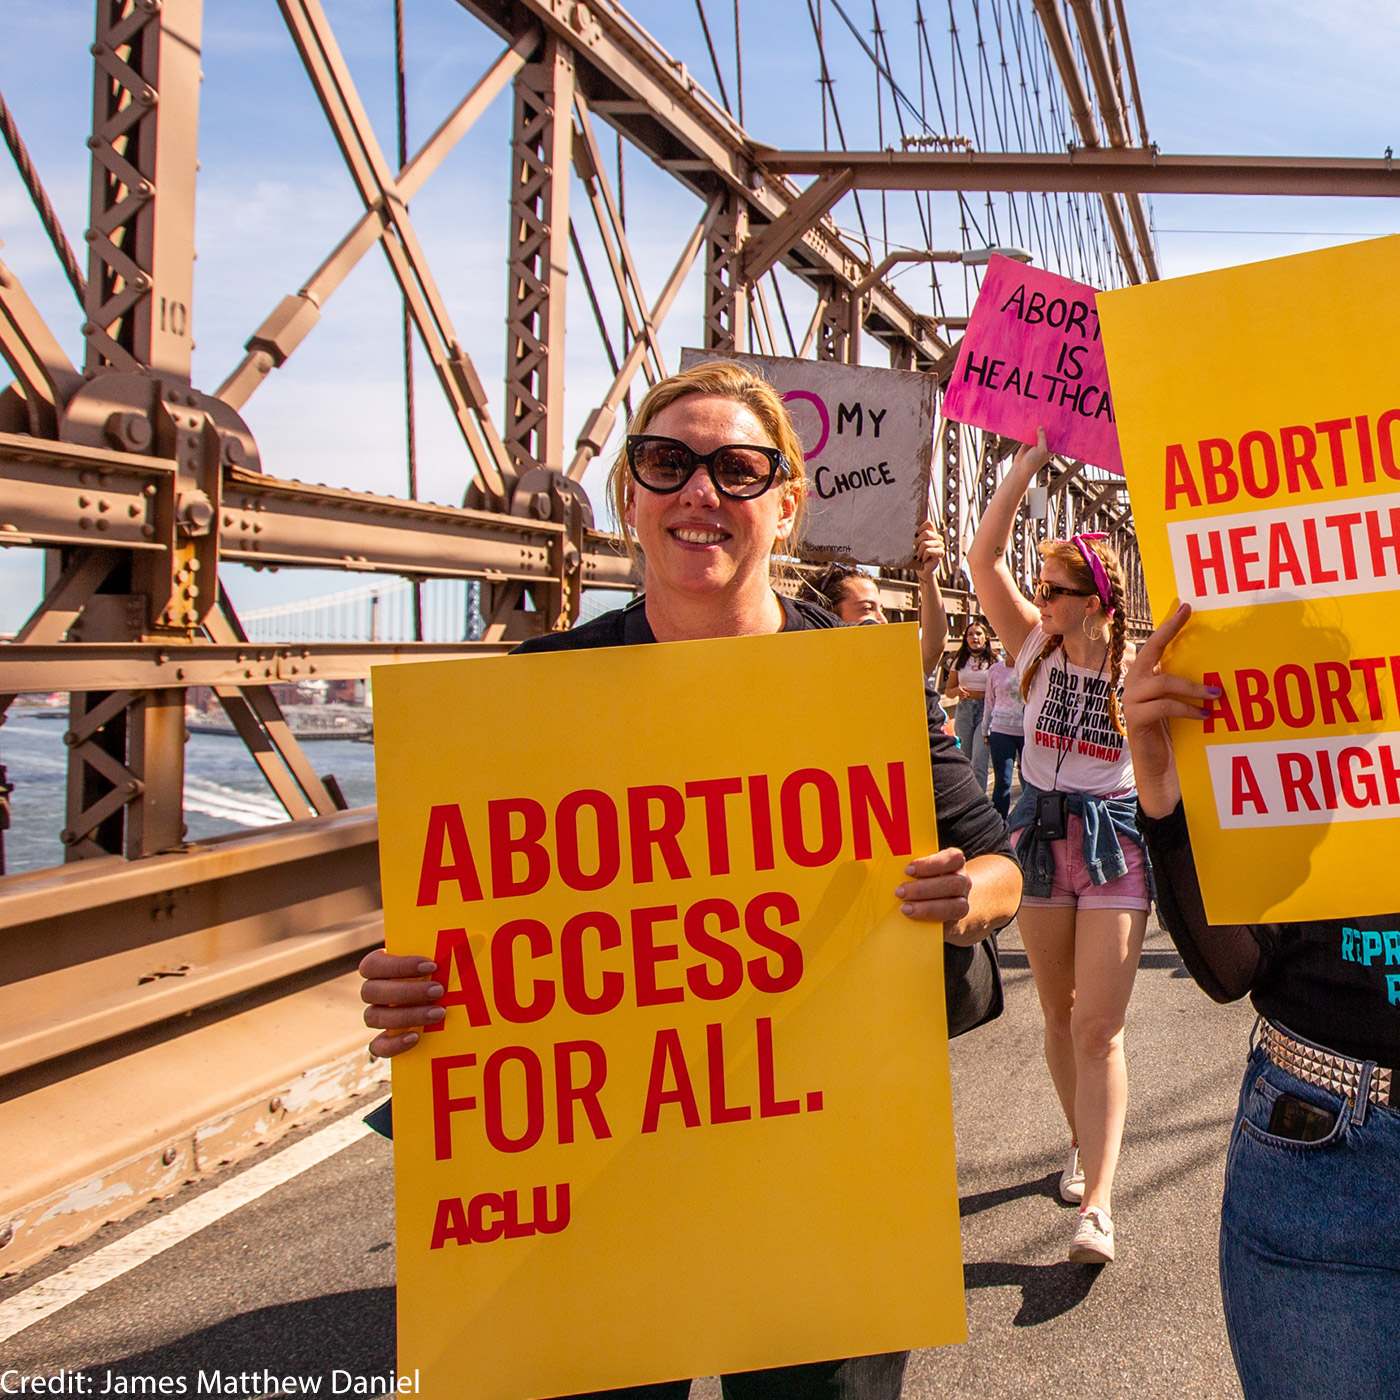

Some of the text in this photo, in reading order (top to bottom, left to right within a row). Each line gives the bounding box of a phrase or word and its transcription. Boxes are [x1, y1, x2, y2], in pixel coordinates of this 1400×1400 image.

[1056, 342, 1089, 380] IS
[963, 351, 1116, 423] HEALTHCA
[837, 402, 887, 438] MY
[814, 461, 896, 499] CHOICE
[1046, 683, 1080, 708] FIERCE
[1049, 667, 1079, 692] BOLD
[1040, 699, 1078, 724] FUNNY
[1035, 715, 1124, 749] STRONG WOMAN
[1035, 730, 1121, 763] PRETTY WOMAN
[1231, 756, 1269, 816] A
[416, 761, 912, 908] ABORTION
[422, 891, 805, 1033] ACCESS
[430, 1016, 824, 1161] FOR ALL.
[429, 1182, 571, 1250] ACLU
